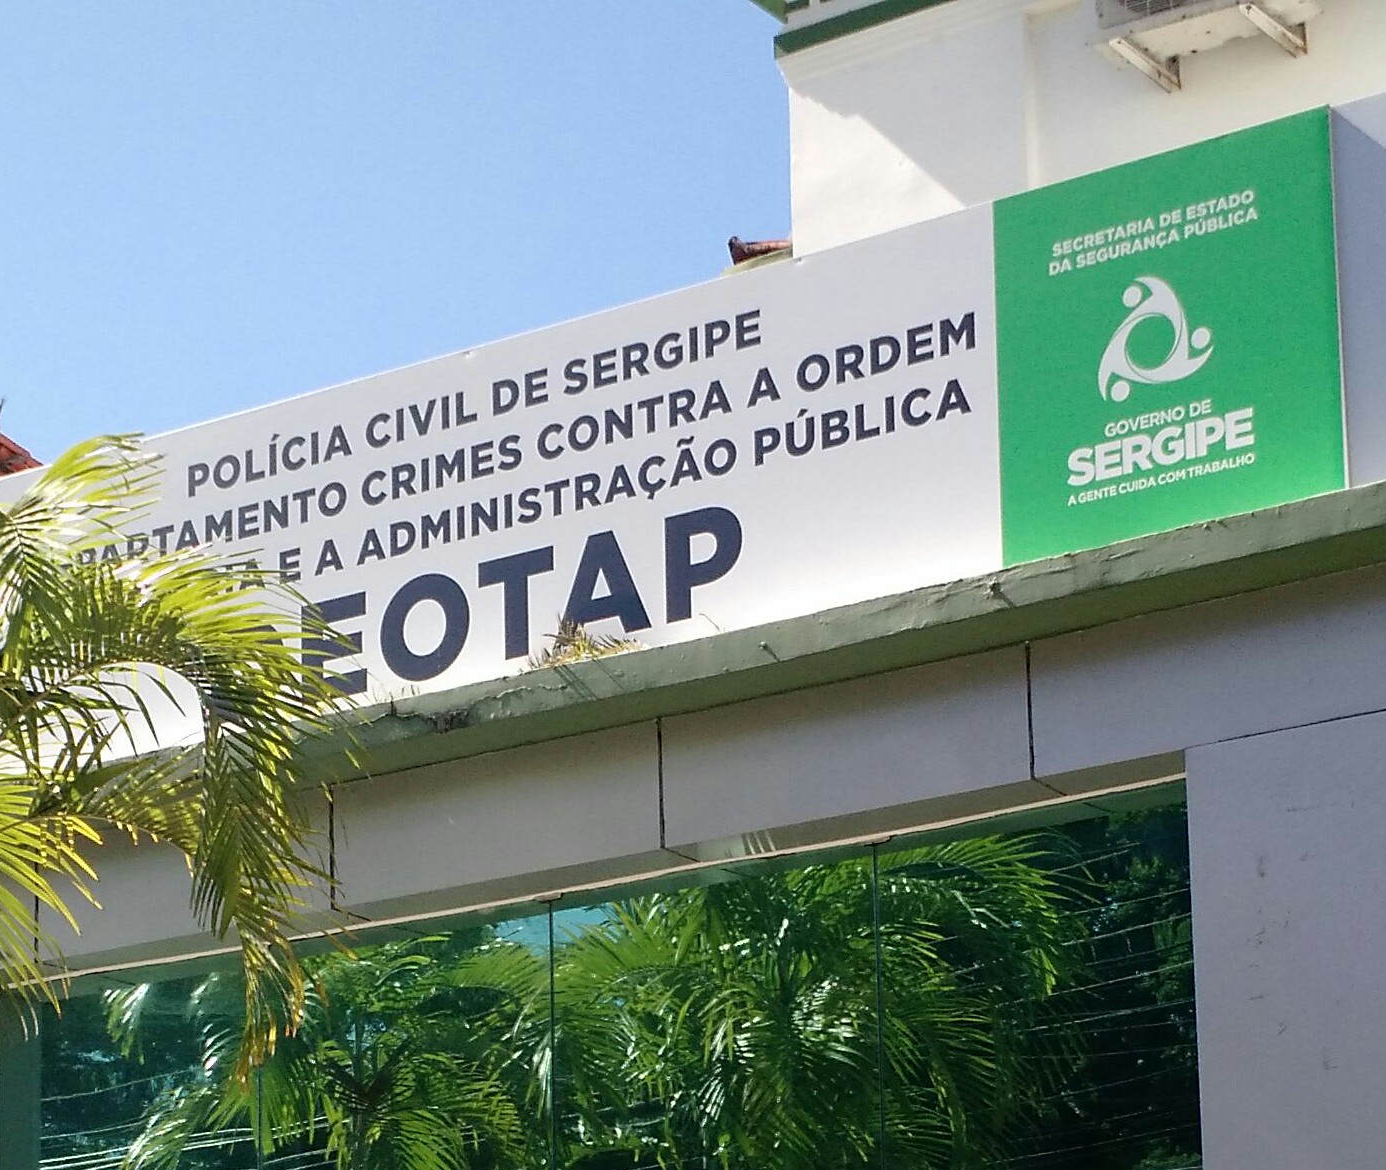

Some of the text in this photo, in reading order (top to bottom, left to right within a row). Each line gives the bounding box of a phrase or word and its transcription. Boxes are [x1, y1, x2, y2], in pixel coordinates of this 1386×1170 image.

[1048, 207, 1258, 276] DA SEGURANÇA PÚBLICA
[1052, 190, 1254, 257] SECRETARIA DE ESTADO
[188, 309, 761, 497] POLÍCIA CIVIL DE SERGIPE
[361, 434, 522, 506] CRIMES
[537, 379, 732, 460] CONTRA
[746, 367, 781, 408] A
[796, 311, 976, 393] ORDEM
[1104, 399, 1212, 437] GOVERNO DE
[278, 547, 302, 584] E
[315, 539, 344, 576] A
[357, 436, 737, 566] ADMINISTRAÇÃO
[754, 378, 971, 466] PÚBLICA
[1067, 407, 1255, 486] SERGIPE
[1067, 453, 1255, 507] A GENTE CUIDA COM TRABALHO
[253, 506, 744, 697] EOTAP
